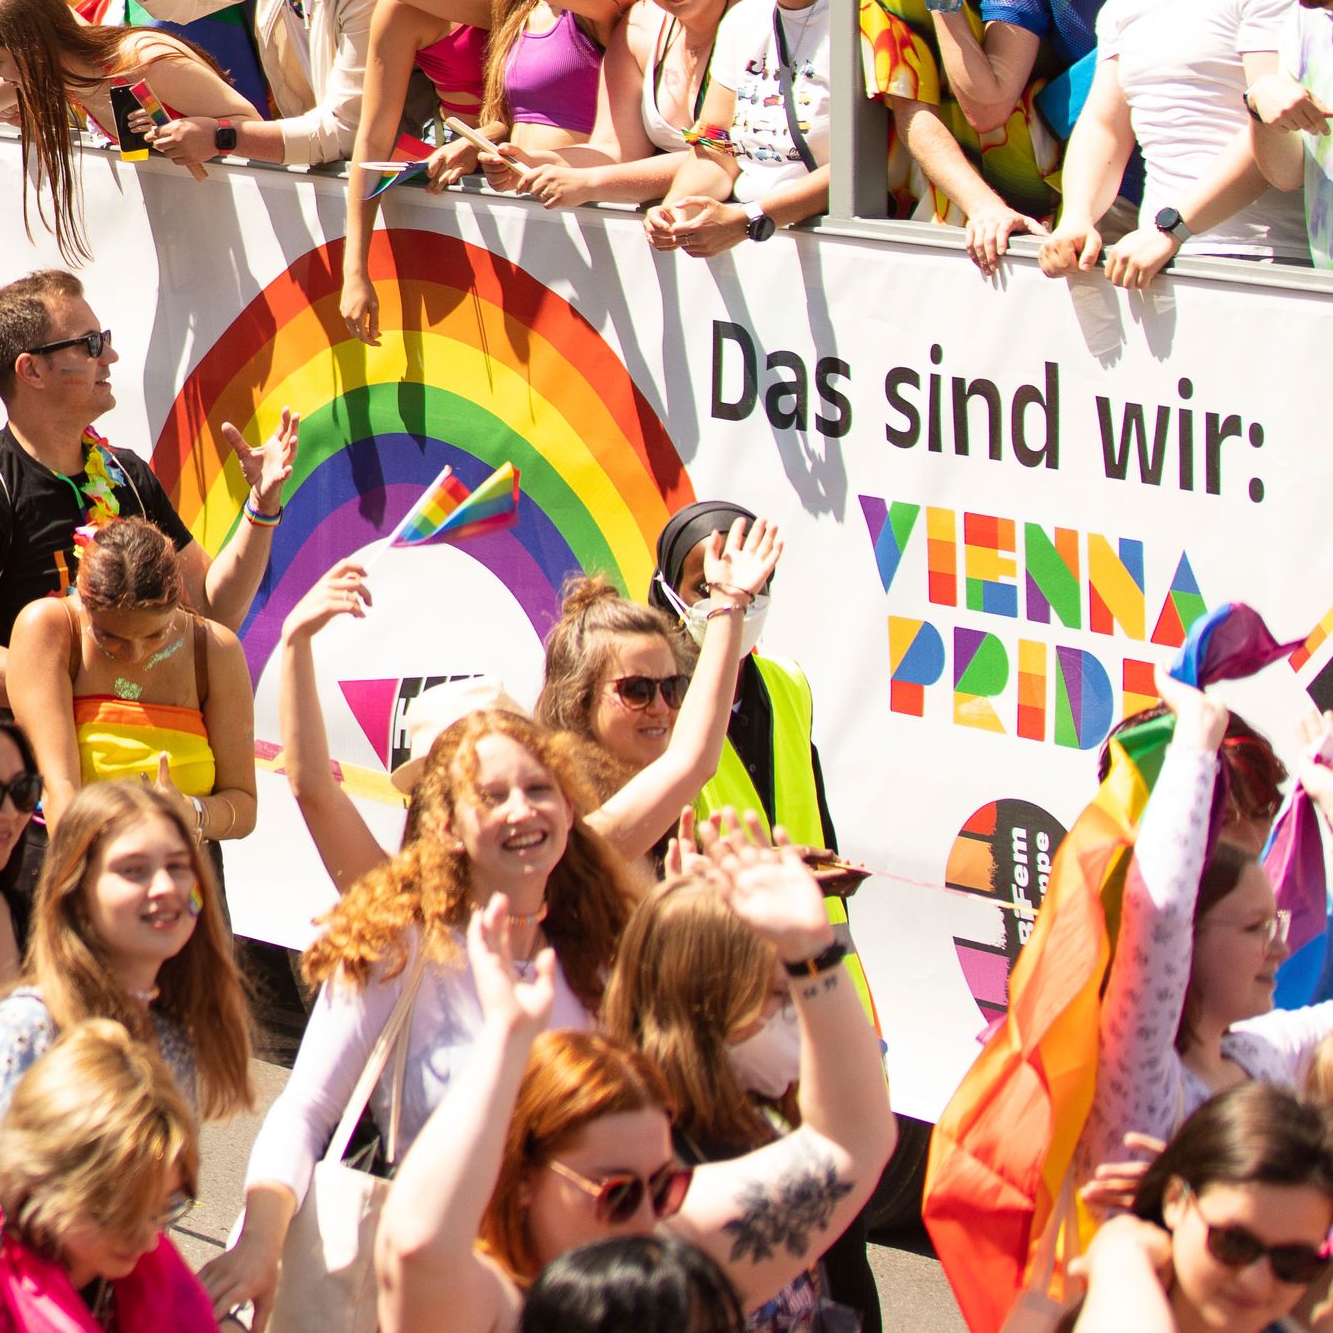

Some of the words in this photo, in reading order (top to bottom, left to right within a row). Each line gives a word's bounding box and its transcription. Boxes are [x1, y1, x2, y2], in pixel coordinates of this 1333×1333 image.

[711, 319, 852, 439] Das
[884, 343, 1060, 470] sind
[1095, 377, 1266, 504] wir:
[858, 494, 1208, 649] VIENNA
